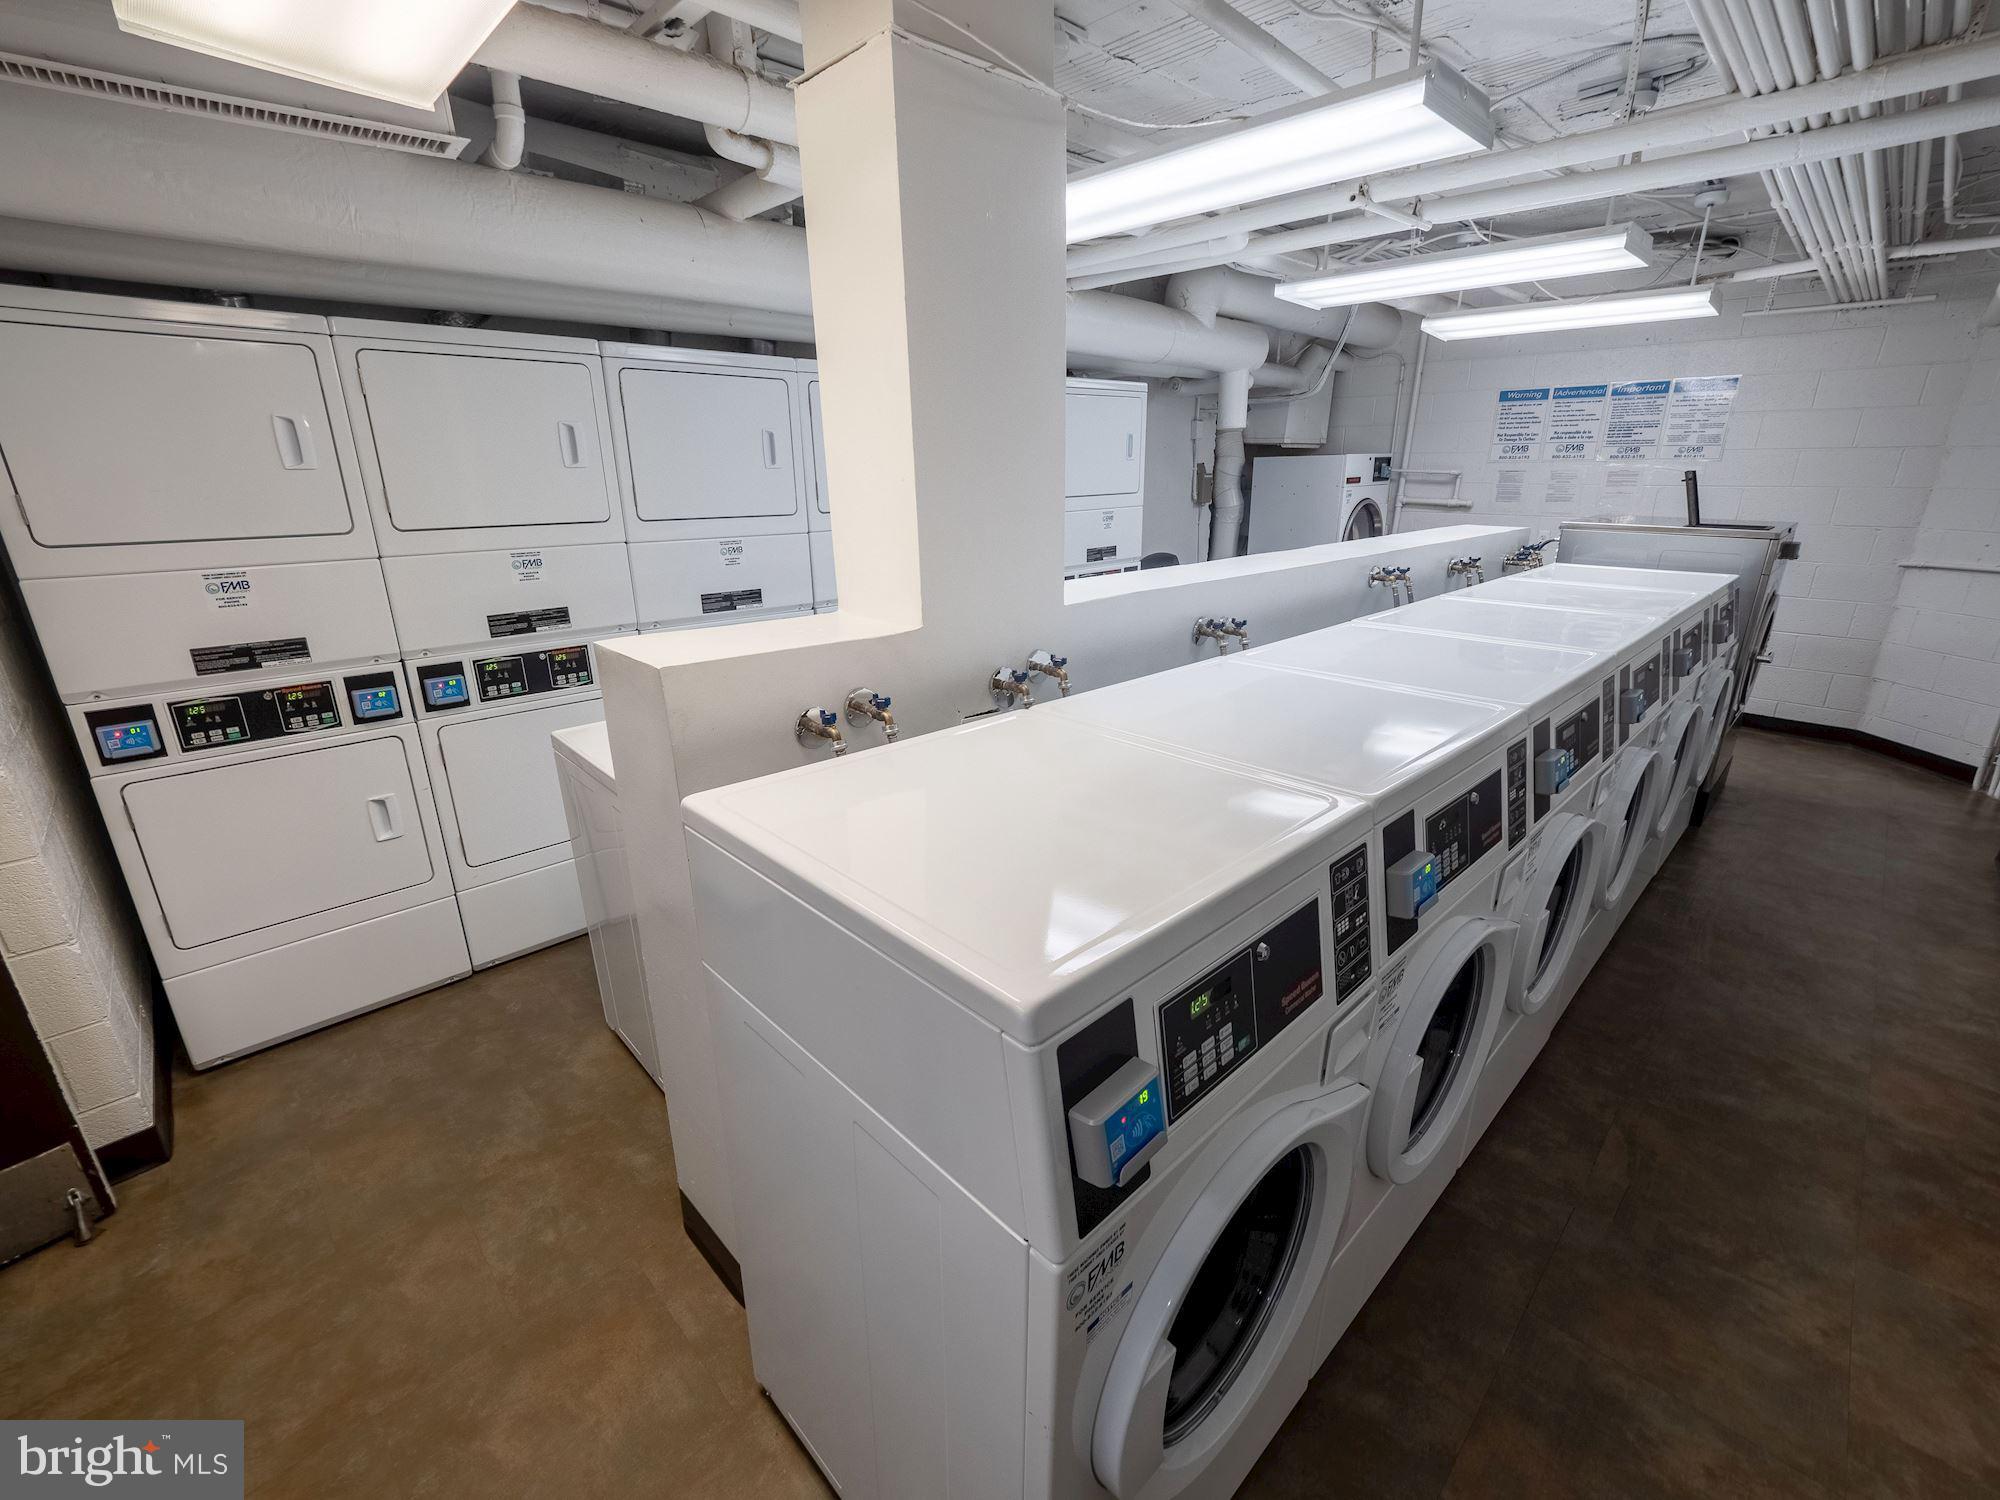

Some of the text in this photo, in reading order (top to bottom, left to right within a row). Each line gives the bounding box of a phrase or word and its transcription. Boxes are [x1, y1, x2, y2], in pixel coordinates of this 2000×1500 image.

[1617, 384, 1665, 393] Important
[1507, 391, 1543, 399] Warning
[1511, 445, 1529, 454] FMB
[1565, 444, 1584, 453] FMB
[1624, 446, 1640, 454] FMB
[728, 546, 744, 556] FMB
[522, 558, 543, 570] FMB
[220, 580, 250, 594] FMB
[1139, 1090, 1148, 1104] 19
[1088, 1240, 1125, 1293] FMB
